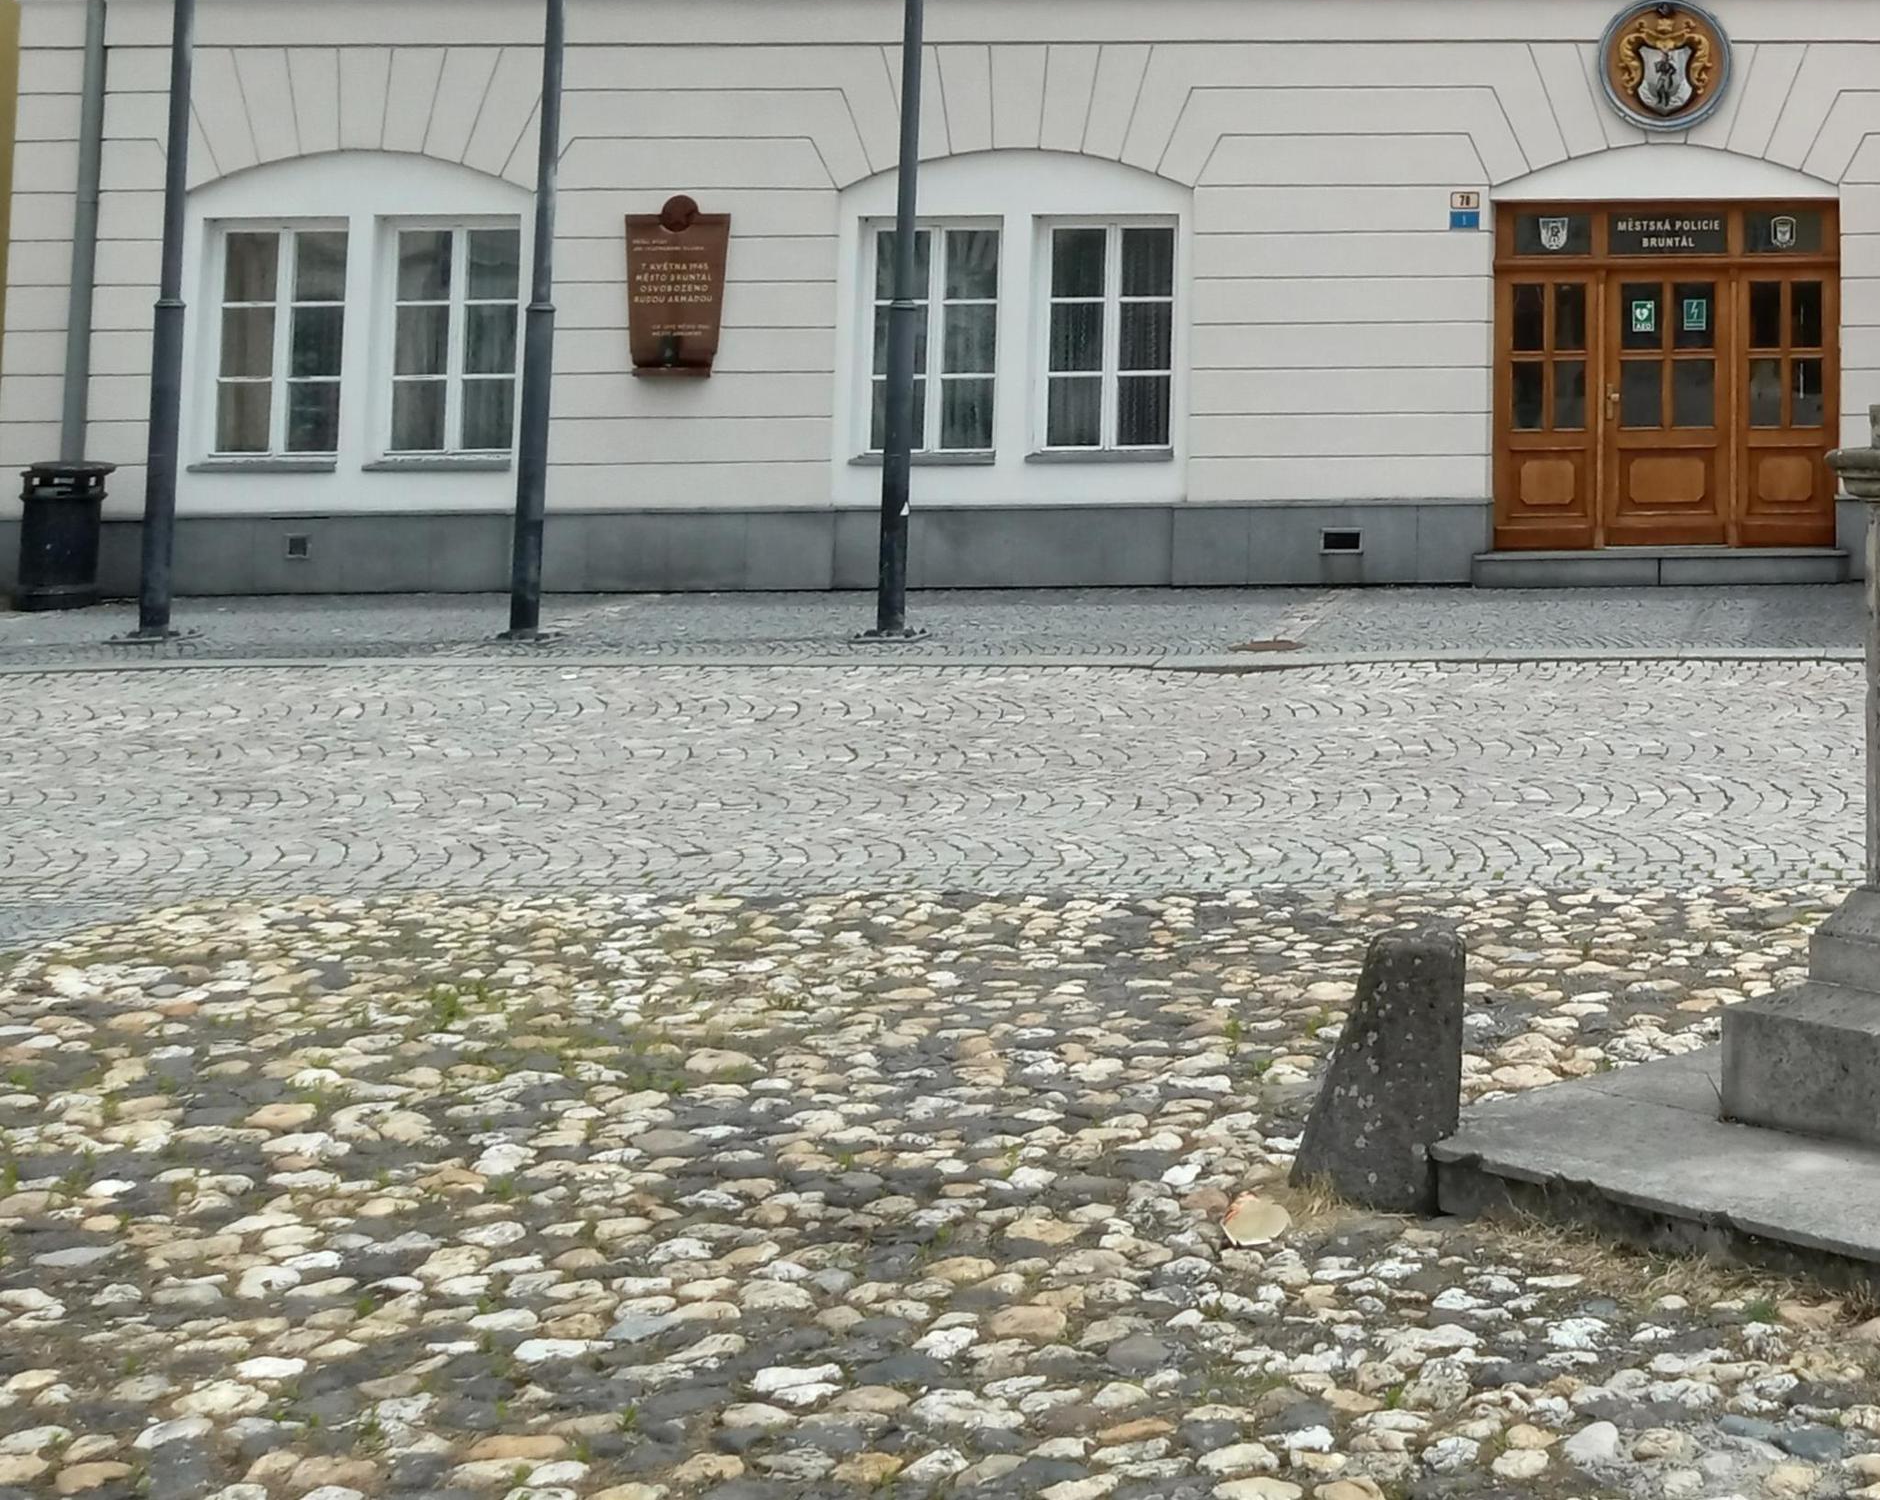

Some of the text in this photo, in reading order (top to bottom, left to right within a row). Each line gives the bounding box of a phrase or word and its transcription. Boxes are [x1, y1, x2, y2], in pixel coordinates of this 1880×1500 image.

[1617, 218, 1720, 231] MĚSTSKÁ POLICIE
[1642, 235, 1695, 247] BRUNTÁL
[635, 273, 668, 282] MĚSTO
